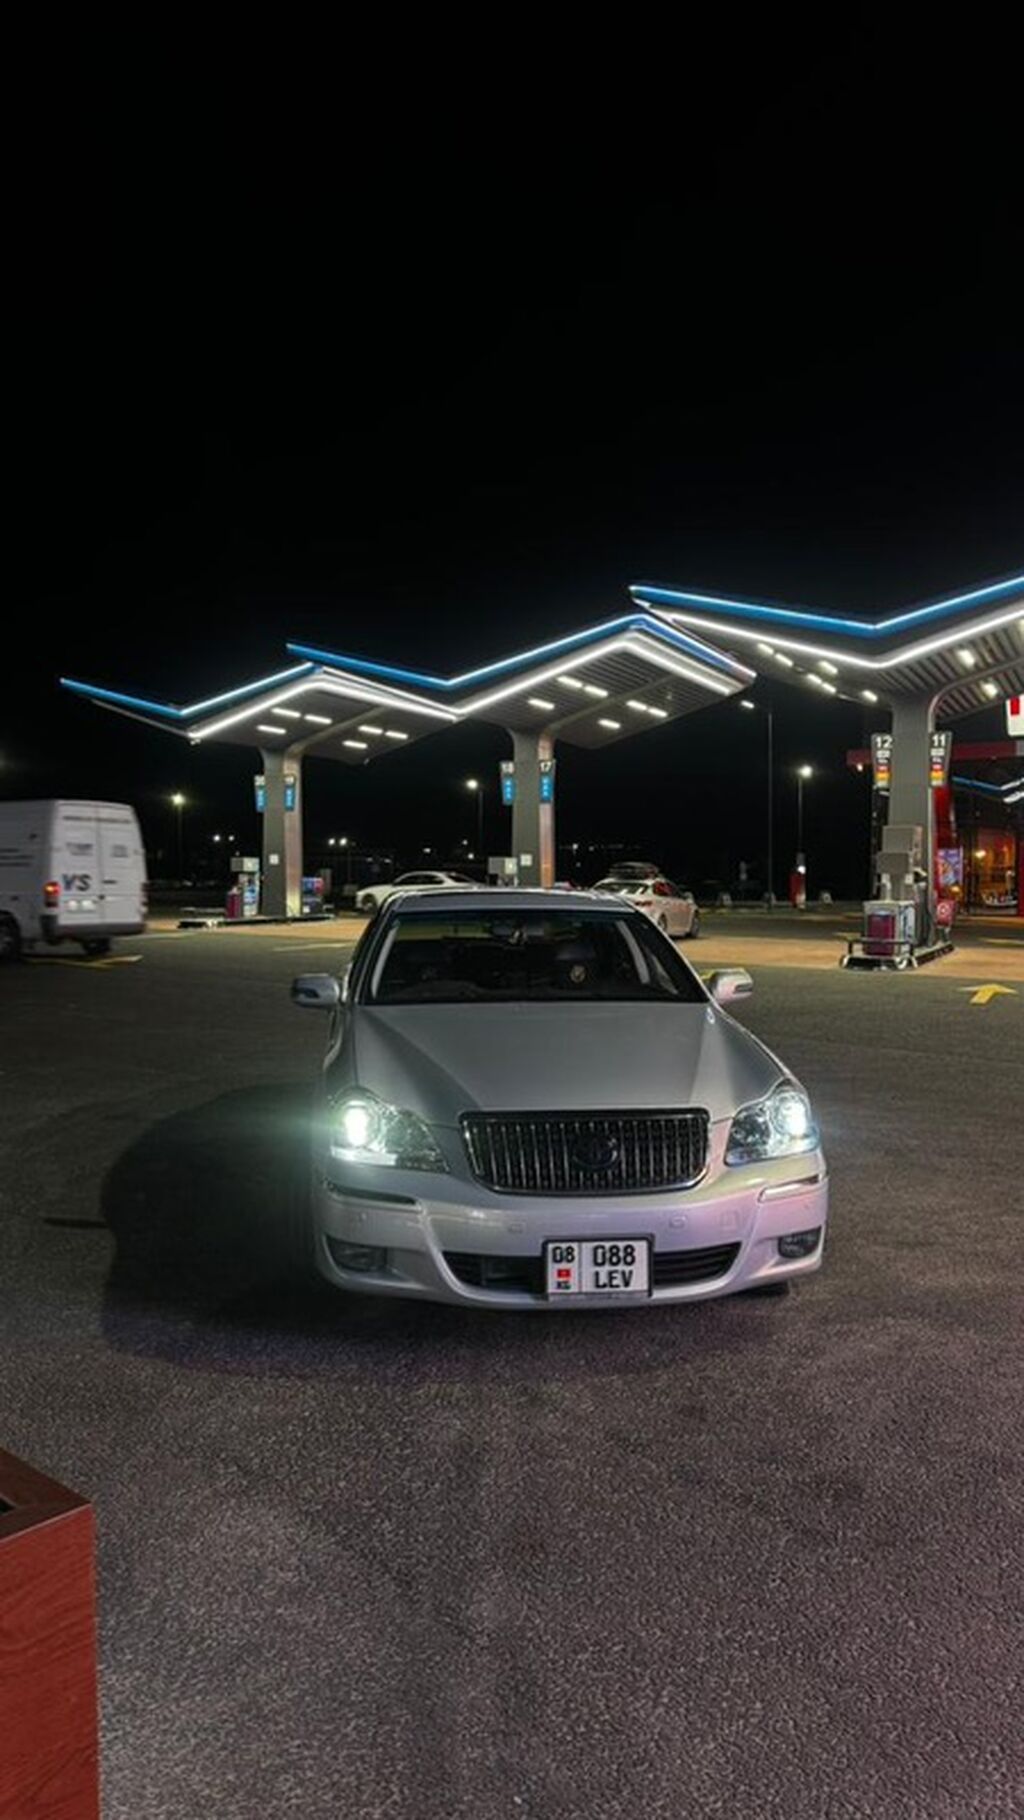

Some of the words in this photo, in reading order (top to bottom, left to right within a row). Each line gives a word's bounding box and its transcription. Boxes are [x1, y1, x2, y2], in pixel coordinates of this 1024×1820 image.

[876, 735, 893, 748] 12
[932, 733, 946, 747] 11
[552, 1246, 575, 1263] 08
[593, 1244, 636, 1266] 088
[594, 1269, 633, 1289] LEV
